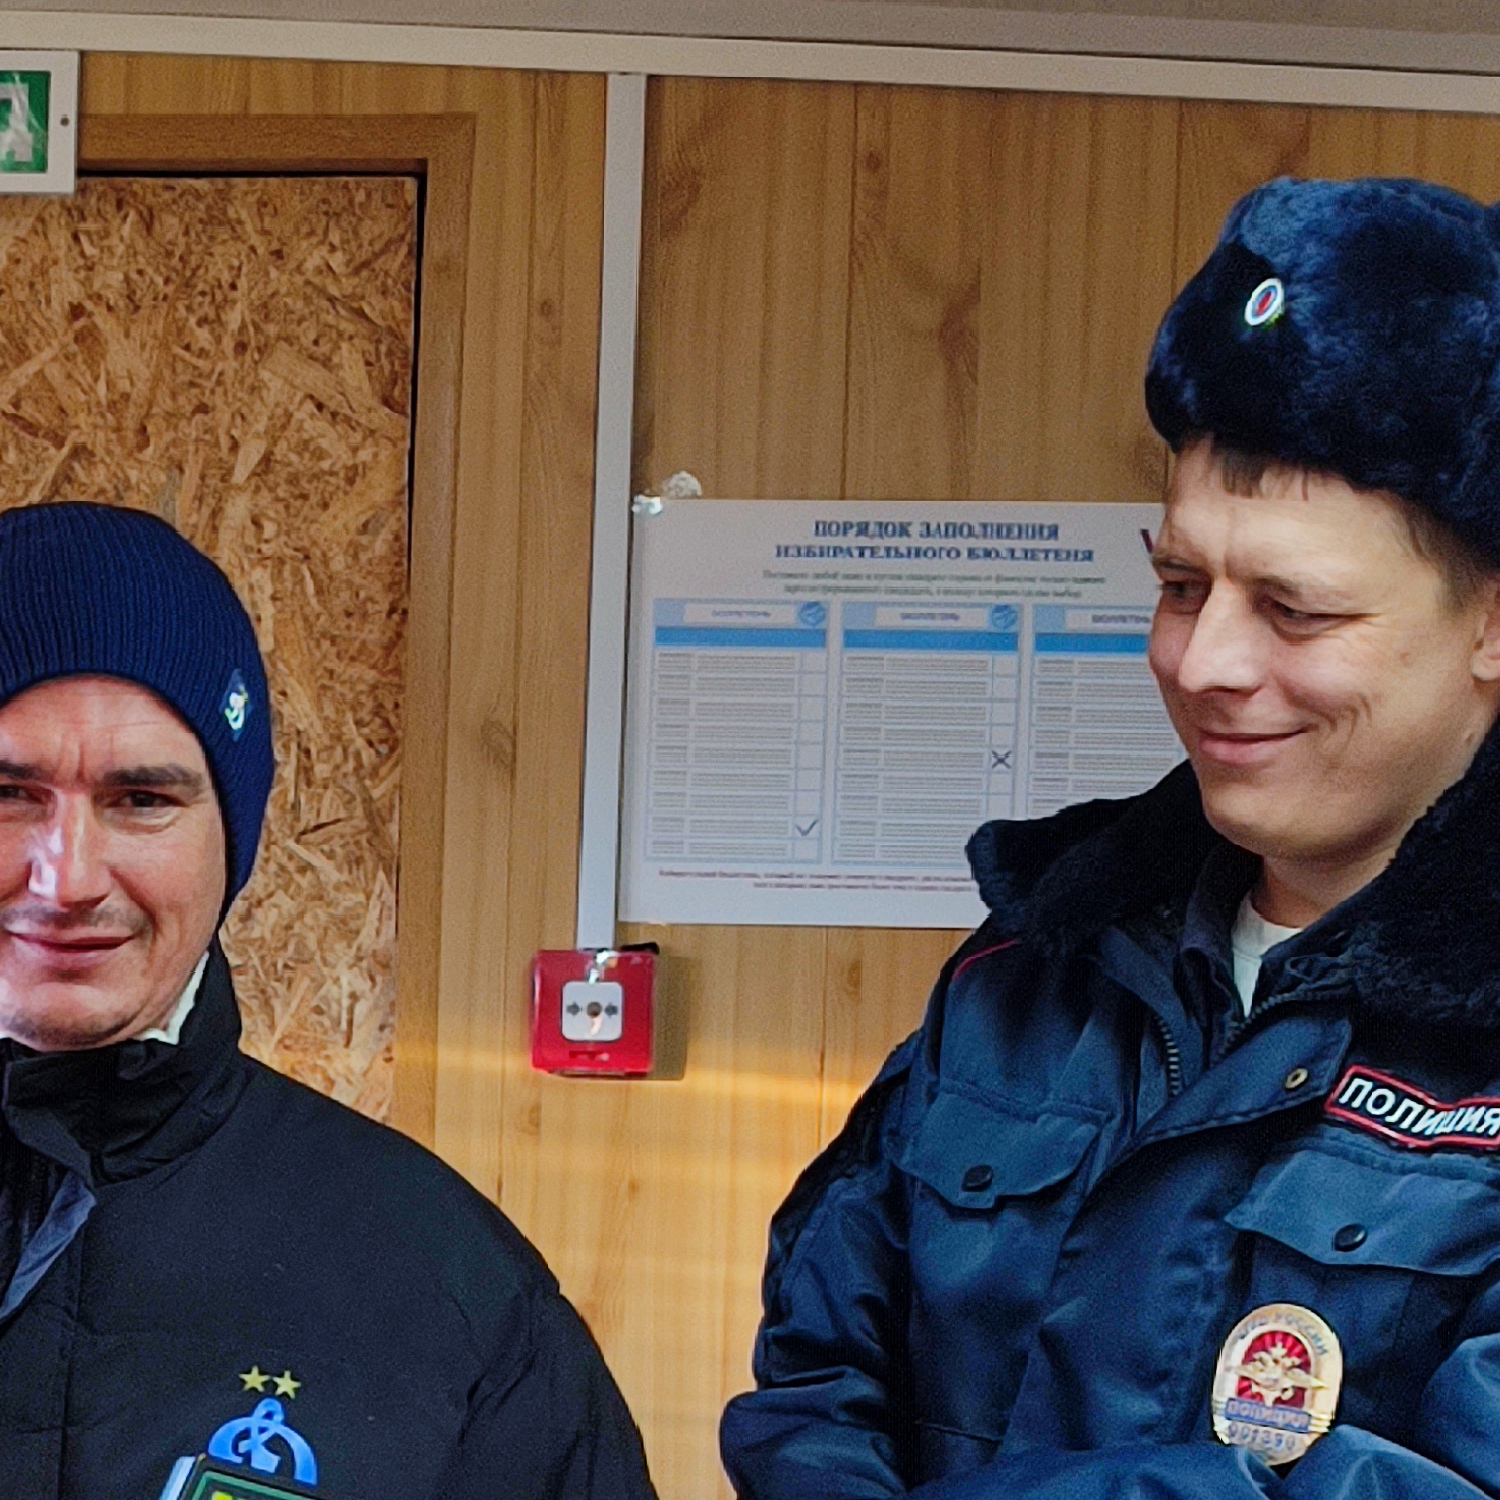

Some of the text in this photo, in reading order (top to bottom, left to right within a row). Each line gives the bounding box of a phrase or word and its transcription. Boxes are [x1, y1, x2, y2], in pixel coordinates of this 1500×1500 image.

[814, 520, 1059, 541] ПОРЯДОК ЗАПОЛНЕНИЯ
[775, 545, 1094, 562] ИЗБИРАТЕЛЬНОГО БЮЛЛЕТЕНЯ
